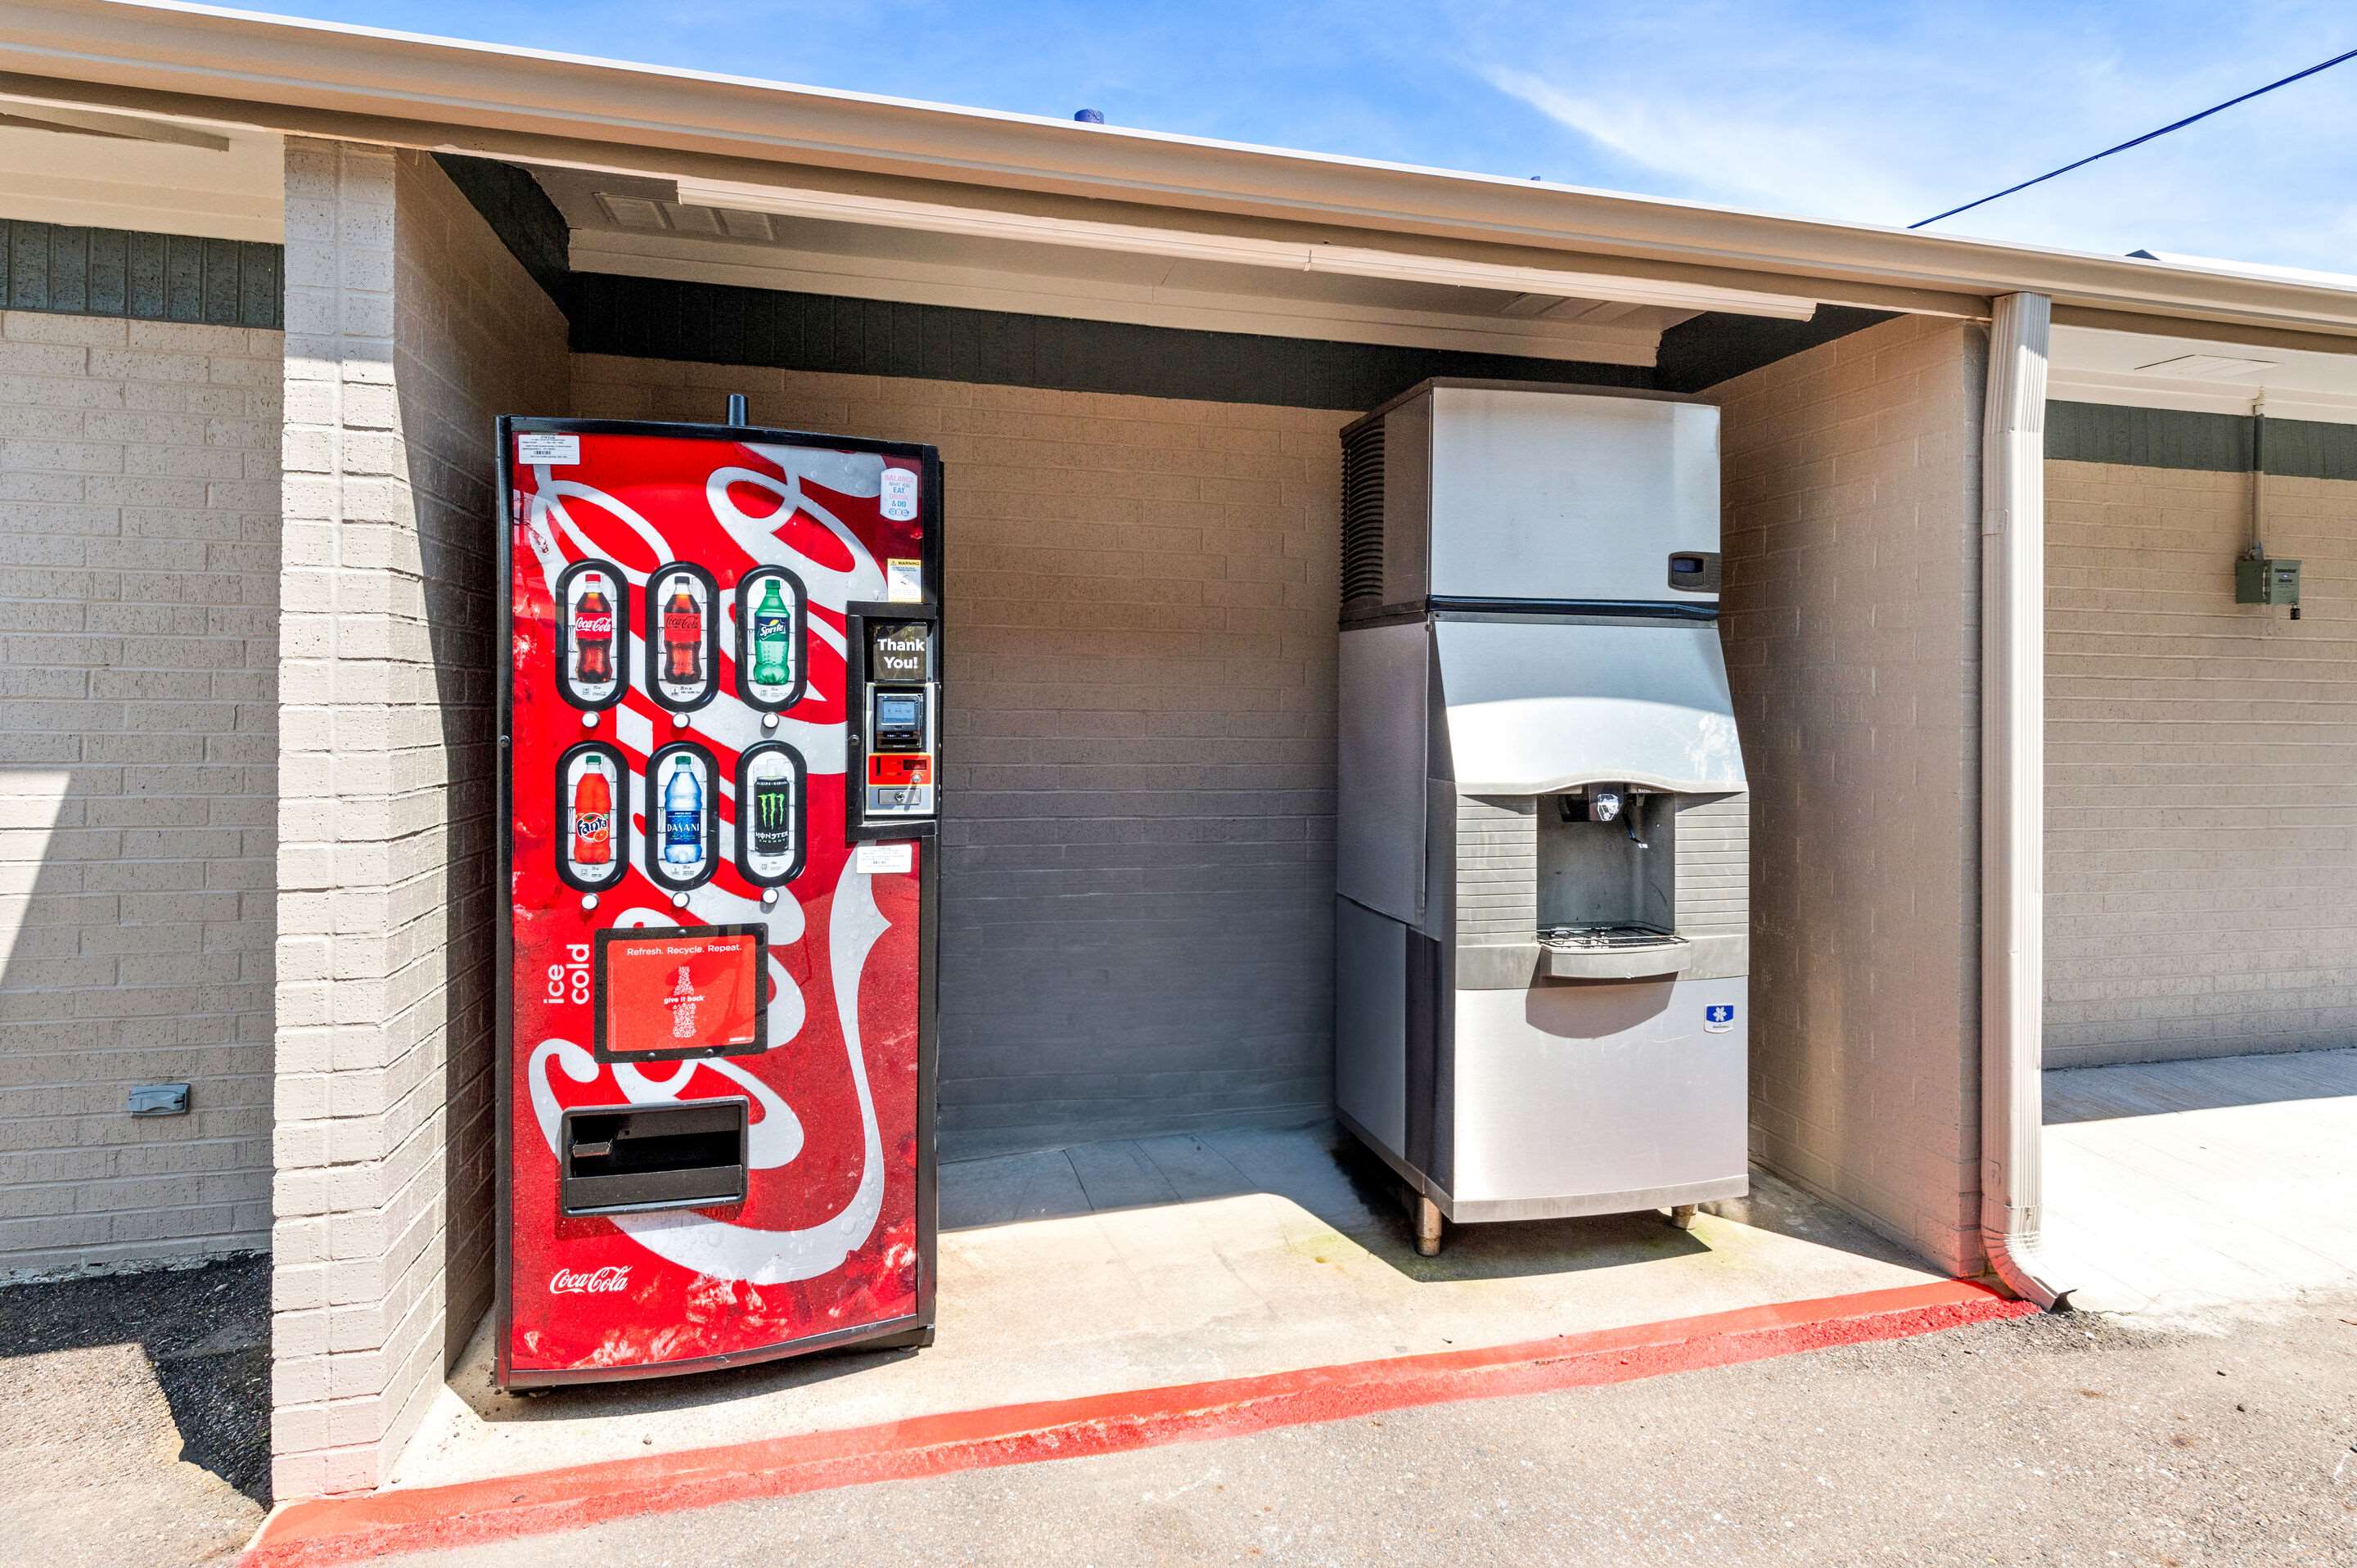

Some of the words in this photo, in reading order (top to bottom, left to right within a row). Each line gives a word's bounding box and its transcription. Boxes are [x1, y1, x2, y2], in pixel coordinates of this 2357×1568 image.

[575, 616, 611, 632] Coca-Cola
[665, 615, 699, 629] Coca-Cola
[759, 623, 784, 637] Sprite
[877, 638, 926, 651] Thank
[884, 656, 917, 669] You!
[667, 822, 700, 832] DASANI
[627, 948, 664, 956] Refresh.
[667, 946, 705, 955] Recycle.
[708, 944, 742, 953] Repeat.
[566, 944, 590, 1005] cold
[543, 964, 565, 1004] ice
[664, 996, 679, 1004] give
[687, 994, 705, 1003] back
[549, 1265, 633, 1294] Coca-Cola
